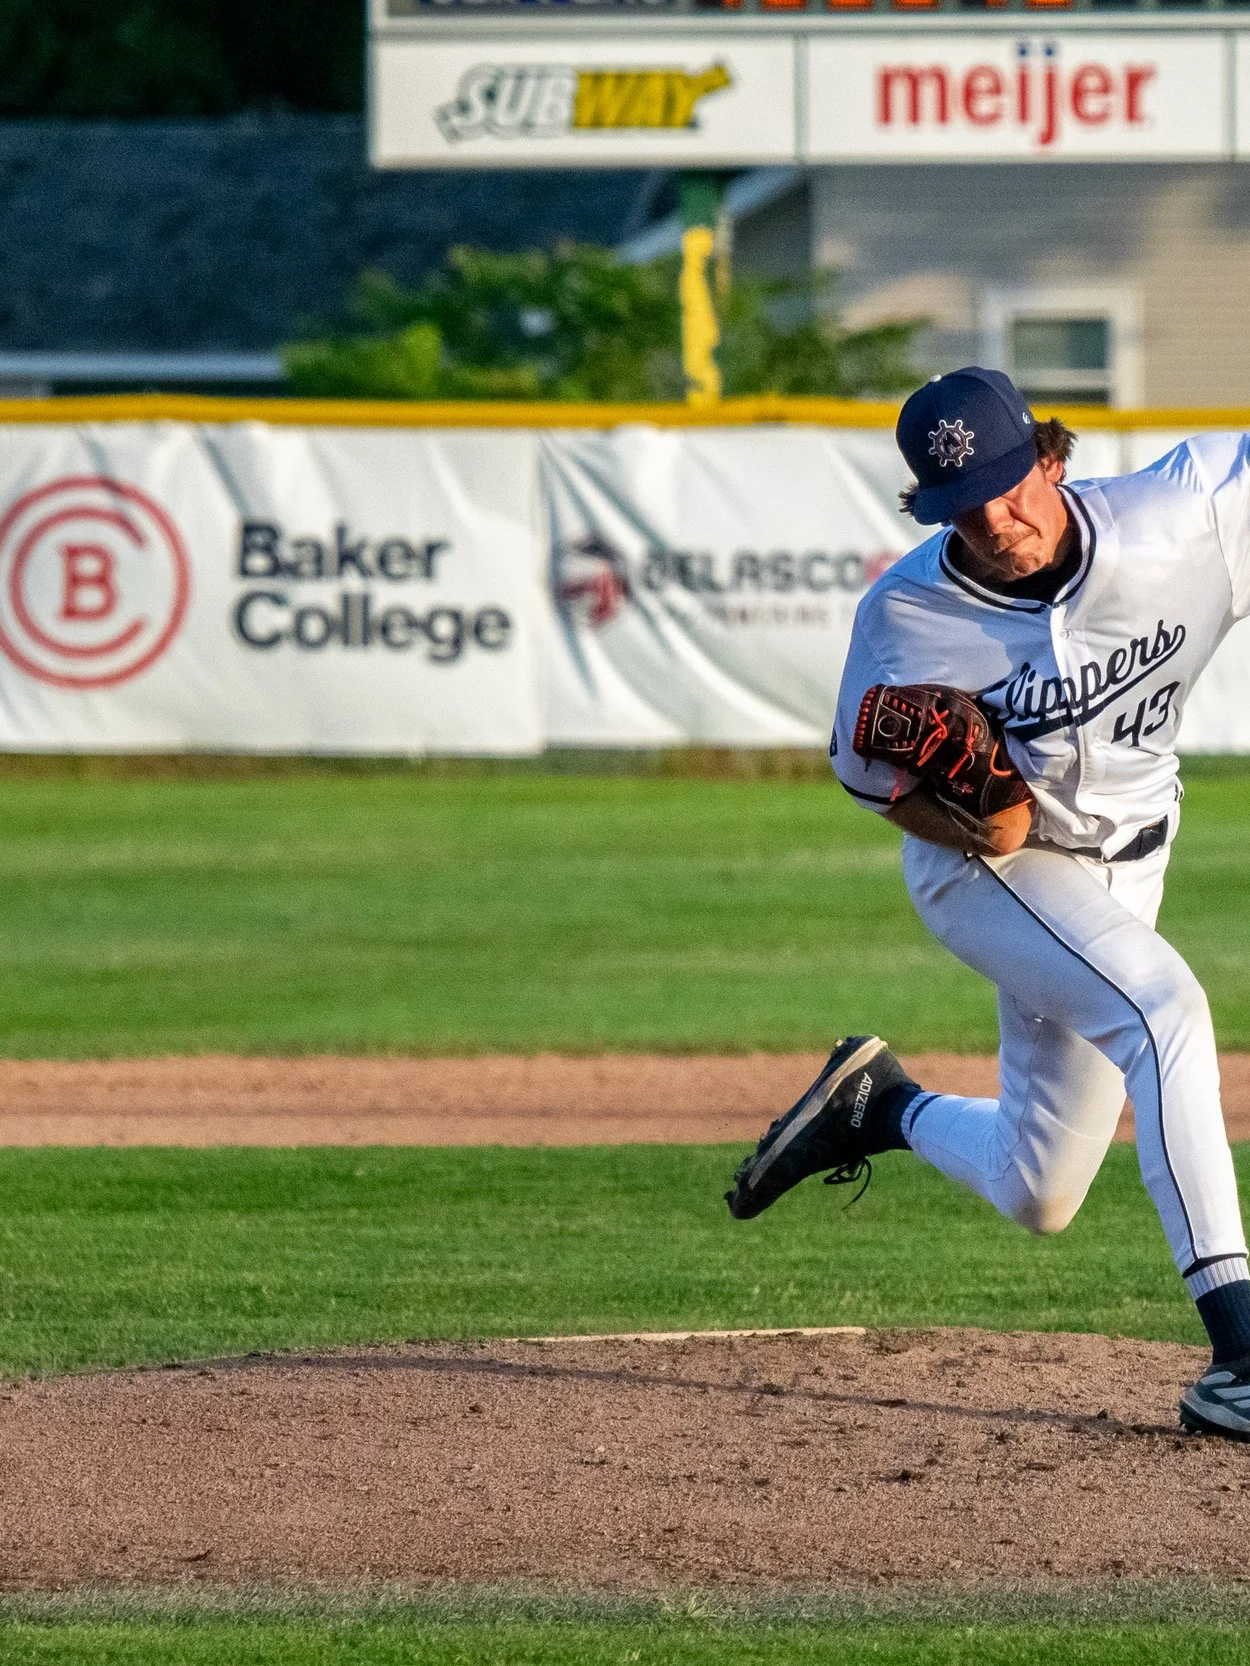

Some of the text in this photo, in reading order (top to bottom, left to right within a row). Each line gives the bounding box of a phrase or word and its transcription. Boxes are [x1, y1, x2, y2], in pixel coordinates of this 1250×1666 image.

[434, 56, 732, 143] SUBWAY
[874, 42, 1157, 147] meijer
[238, 518, 450, 582] Baker
[234, 590, 512, 664] College
[1111, 680, 1181, 749] 43
[851, 1072, 873, 1128] ADIZERO
